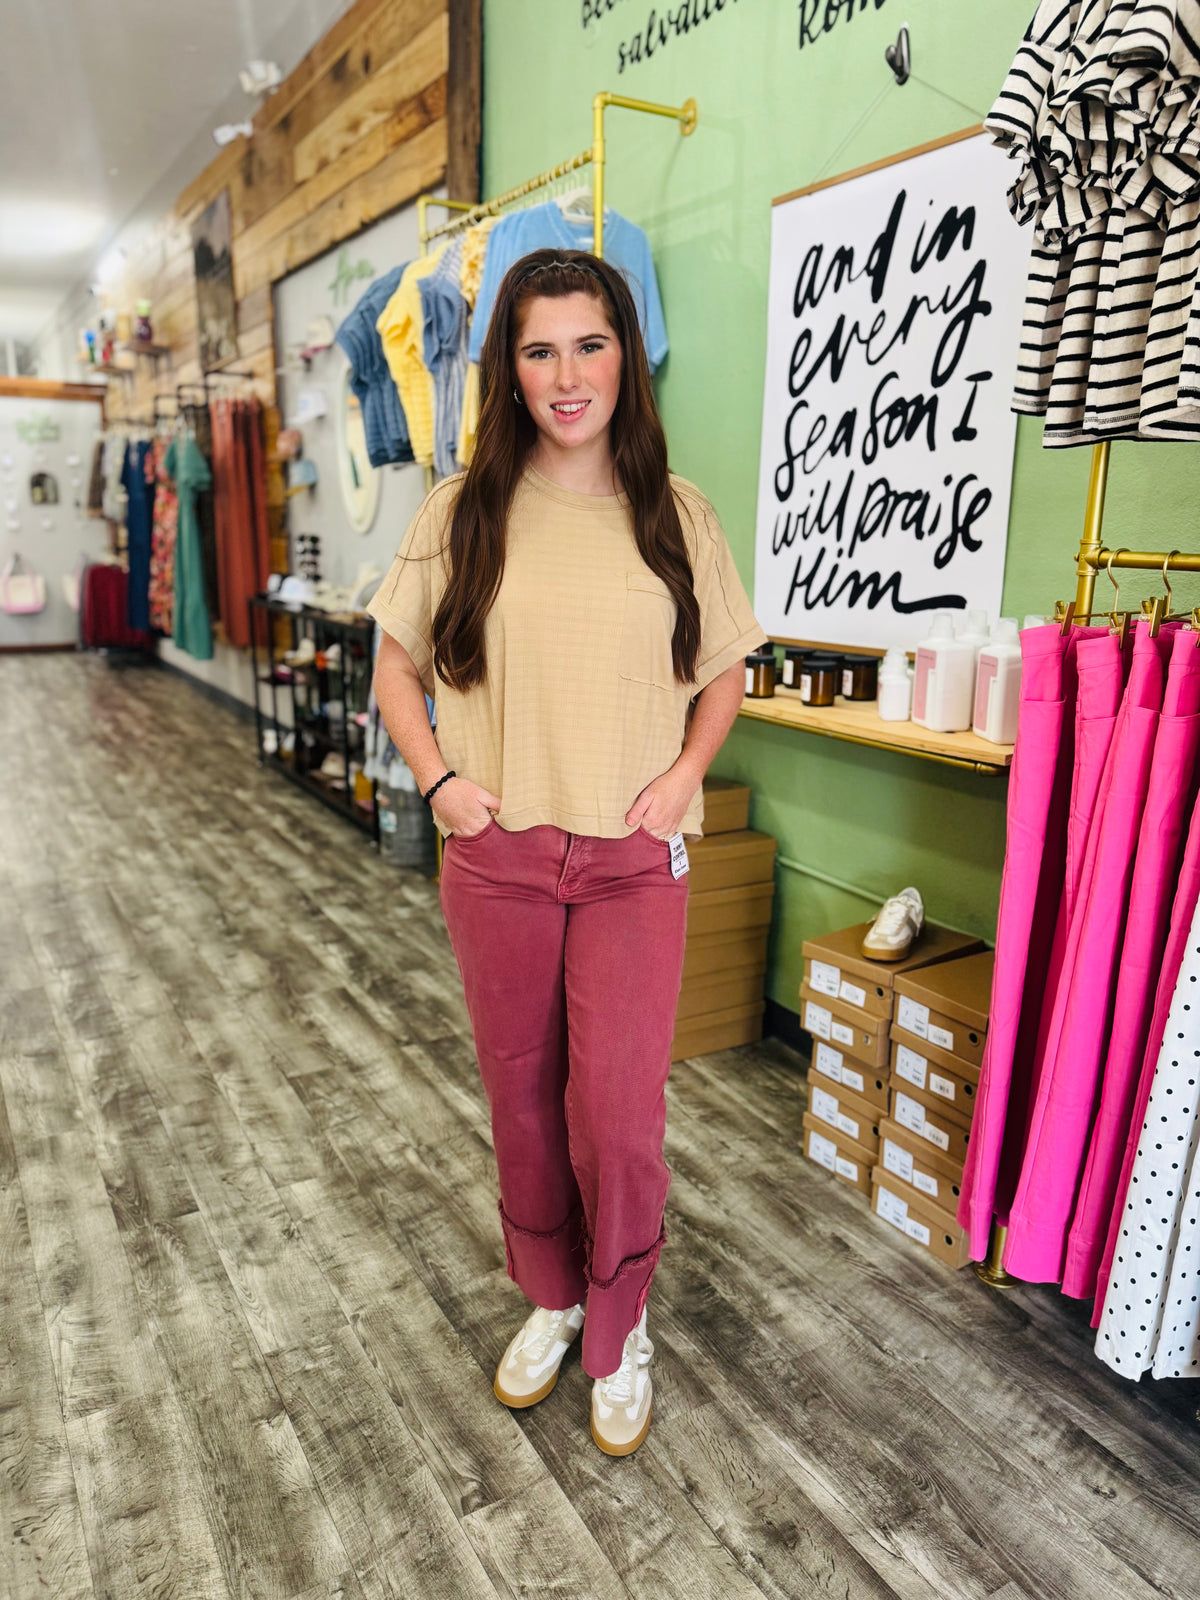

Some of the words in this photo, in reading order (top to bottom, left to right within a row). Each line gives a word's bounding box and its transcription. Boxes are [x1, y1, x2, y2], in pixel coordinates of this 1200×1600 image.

[618, 0, 738, 74] salvati
[793, 189, 907, 319] and
[910, 199, 976, 274] in
[788, 259, 992, 399] every
[774, 371, 939, 503] season
[951, 370, 993, 442] I
[772, 469, 855, 556] will
[847, 473, 993, 570] praise
[784, 546, 968, 616] Him
